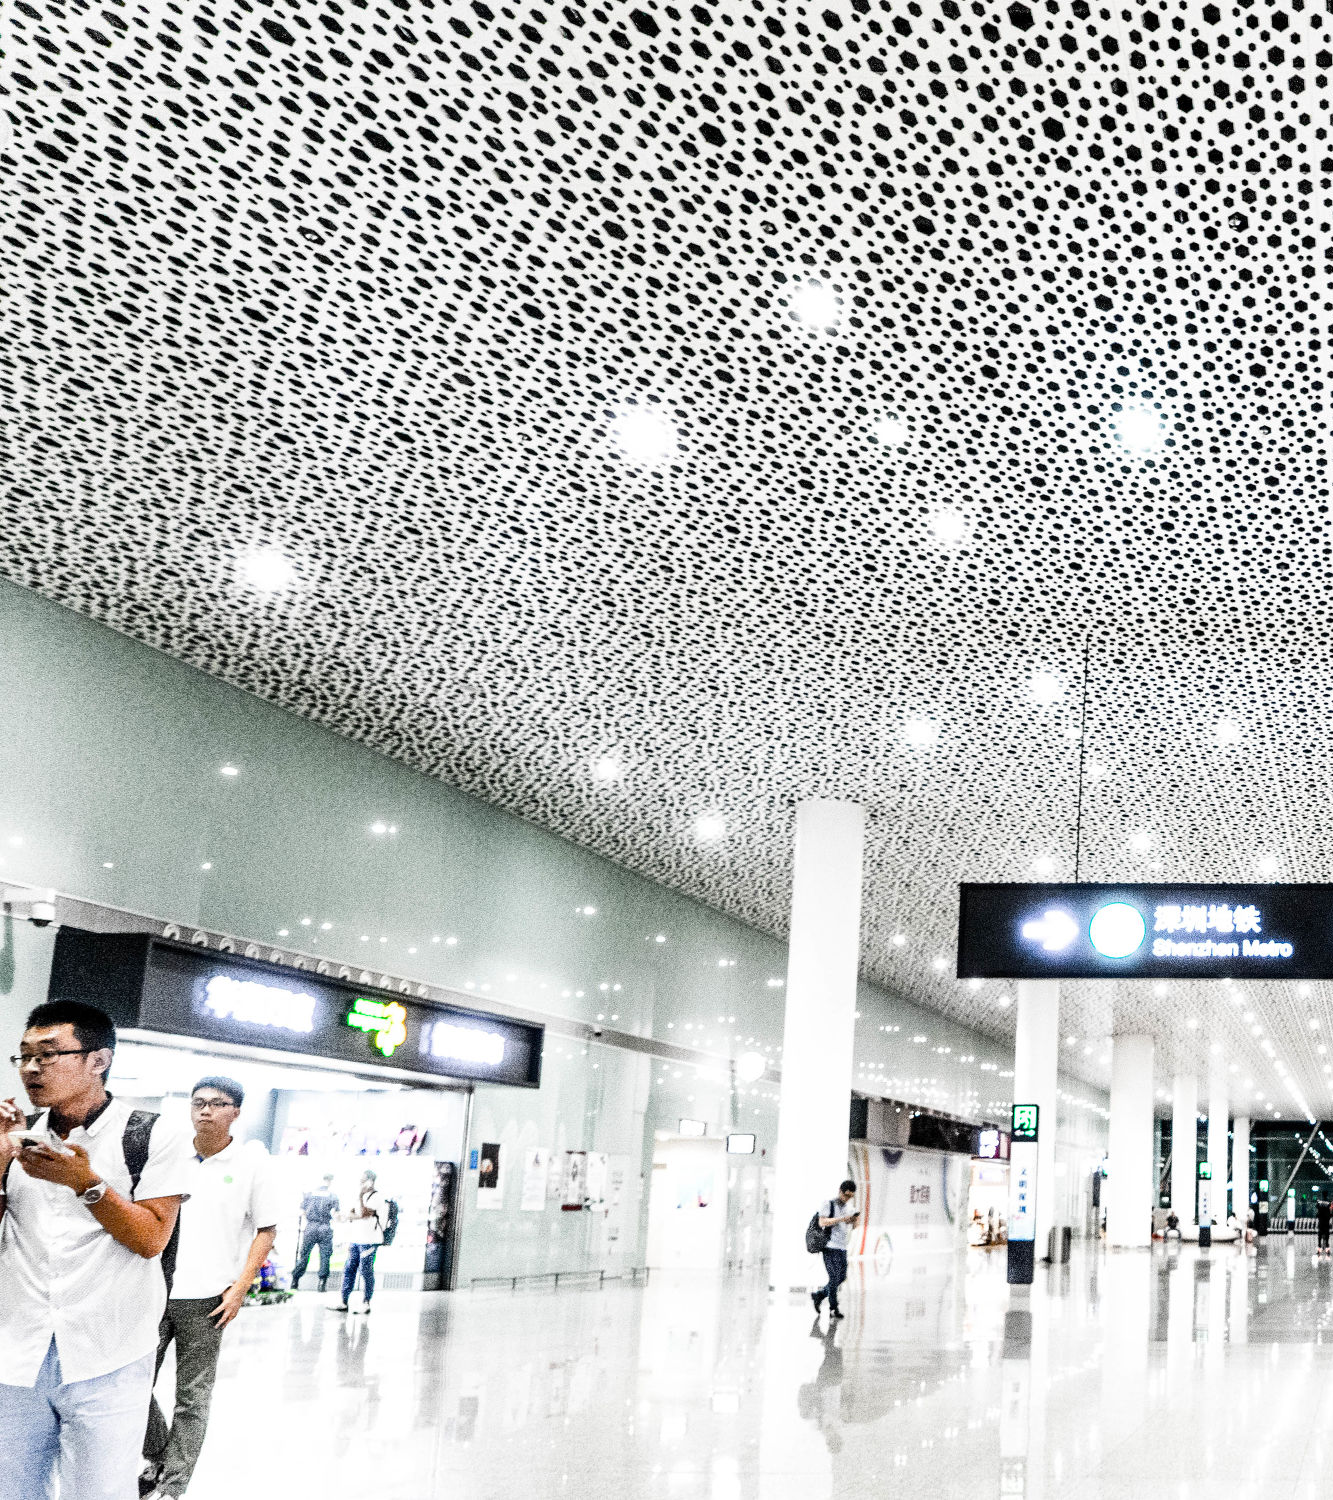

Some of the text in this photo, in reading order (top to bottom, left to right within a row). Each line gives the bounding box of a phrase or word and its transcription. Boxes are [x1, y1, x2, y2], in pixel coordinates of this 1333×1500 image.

[1154, 904, 1262, 933] 深圳地铁
[1153, 938, 1293, 957] Shenzhen Metro
